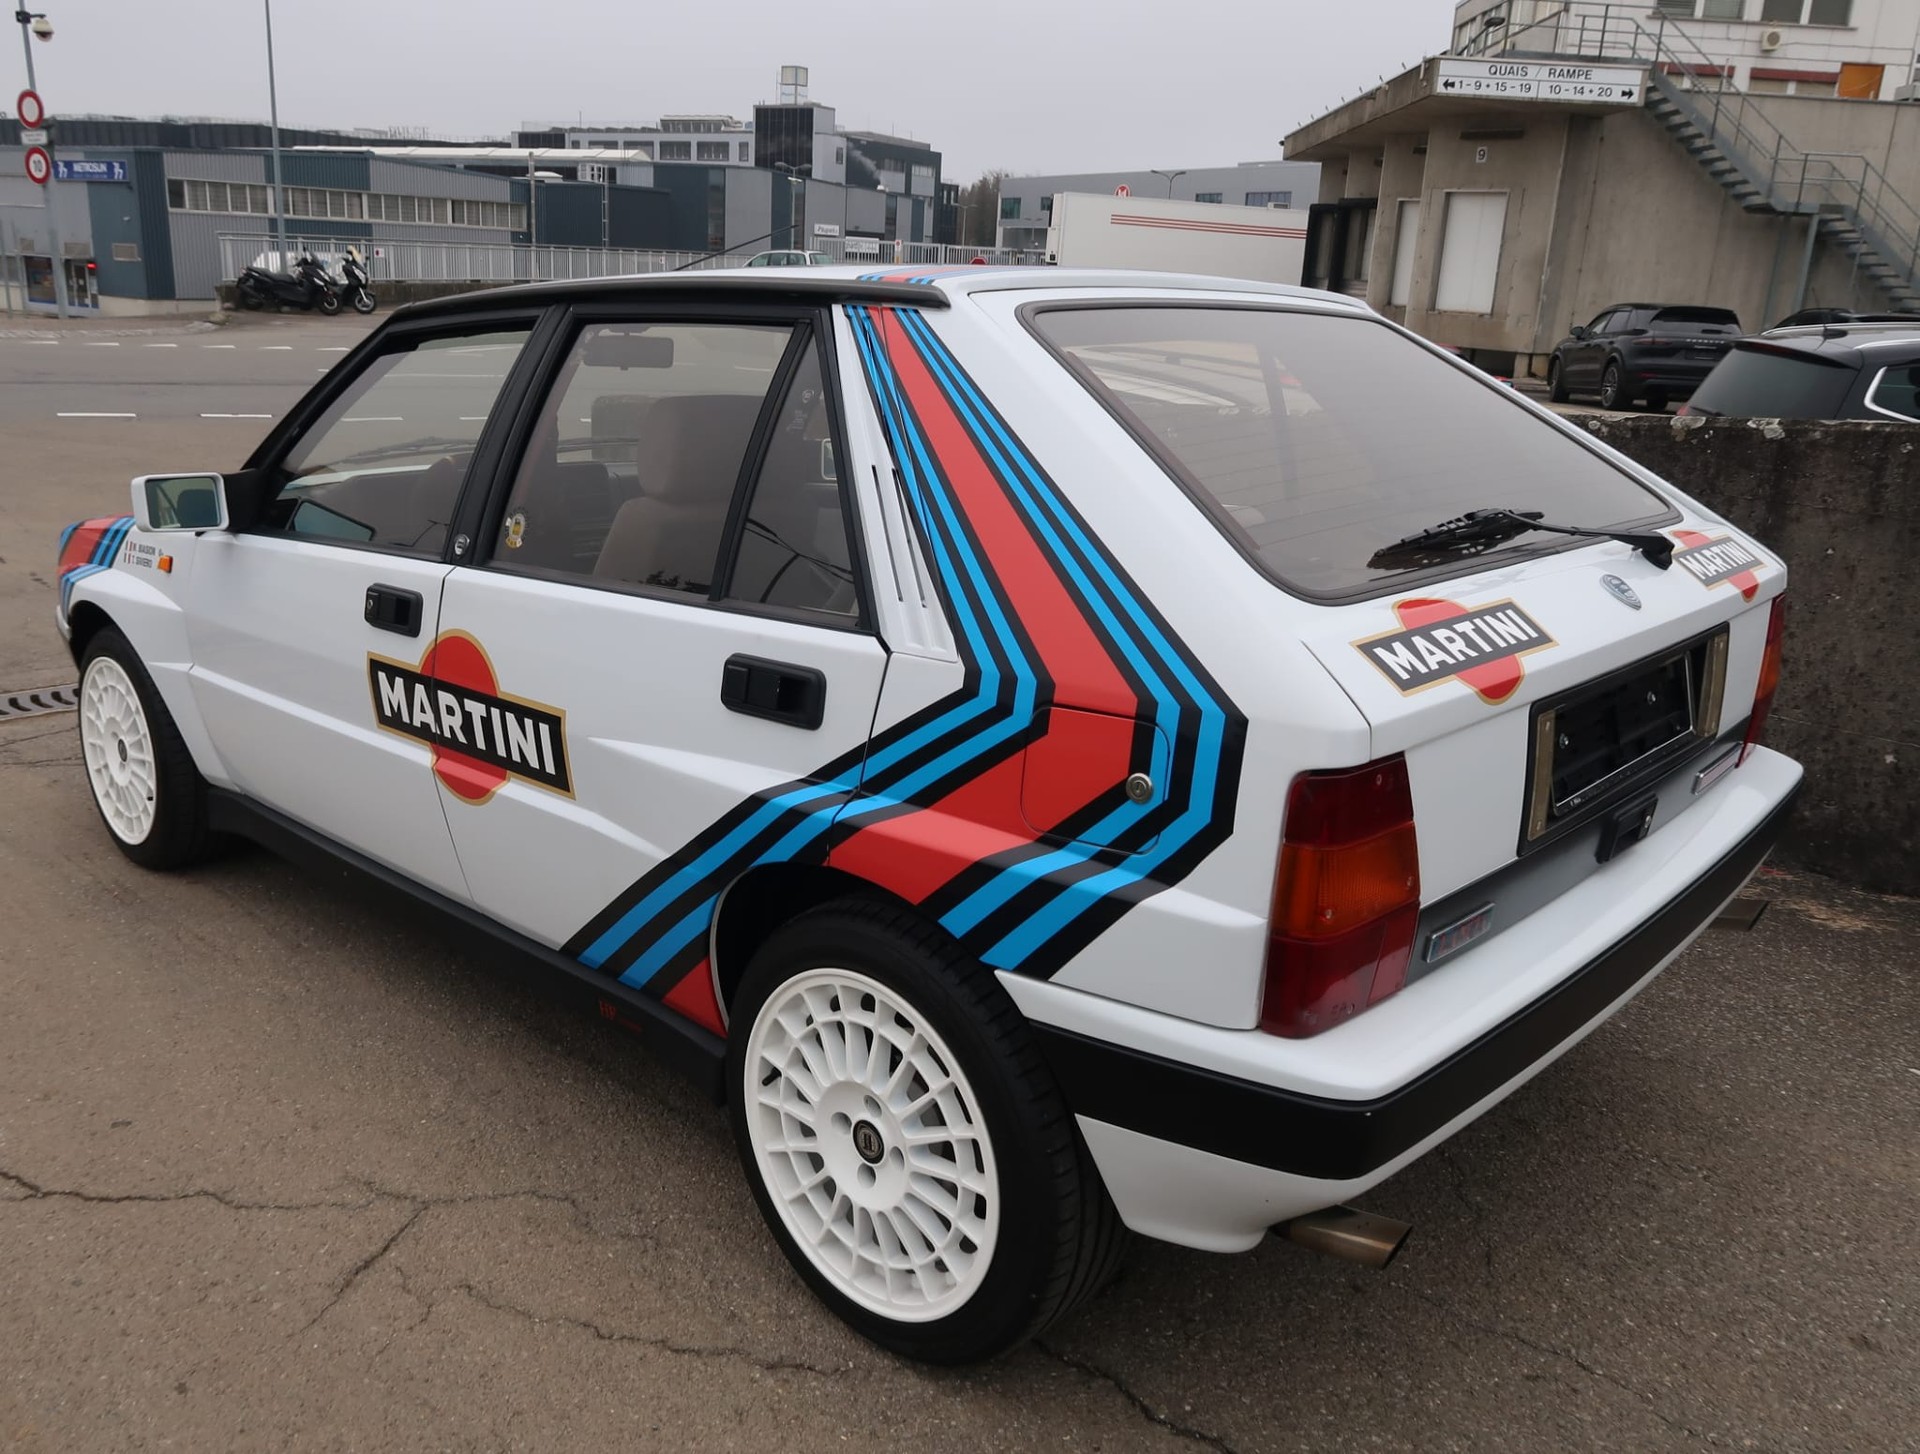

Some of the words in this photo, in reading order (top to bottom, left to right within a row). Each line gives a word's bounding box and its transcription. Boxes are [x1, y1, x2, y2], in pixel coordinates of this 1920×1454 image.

[1488, 65, 1528, 77] QUAIS
[1548, 68, 1592, 80] RAMPE
[1477, 148, 1486, 161] 9
[1680, 541, 1754, 580] MARTINI
[1373, 609, 1539, 681] MARTINI
[376, 669, 556, 775] MARTINI
